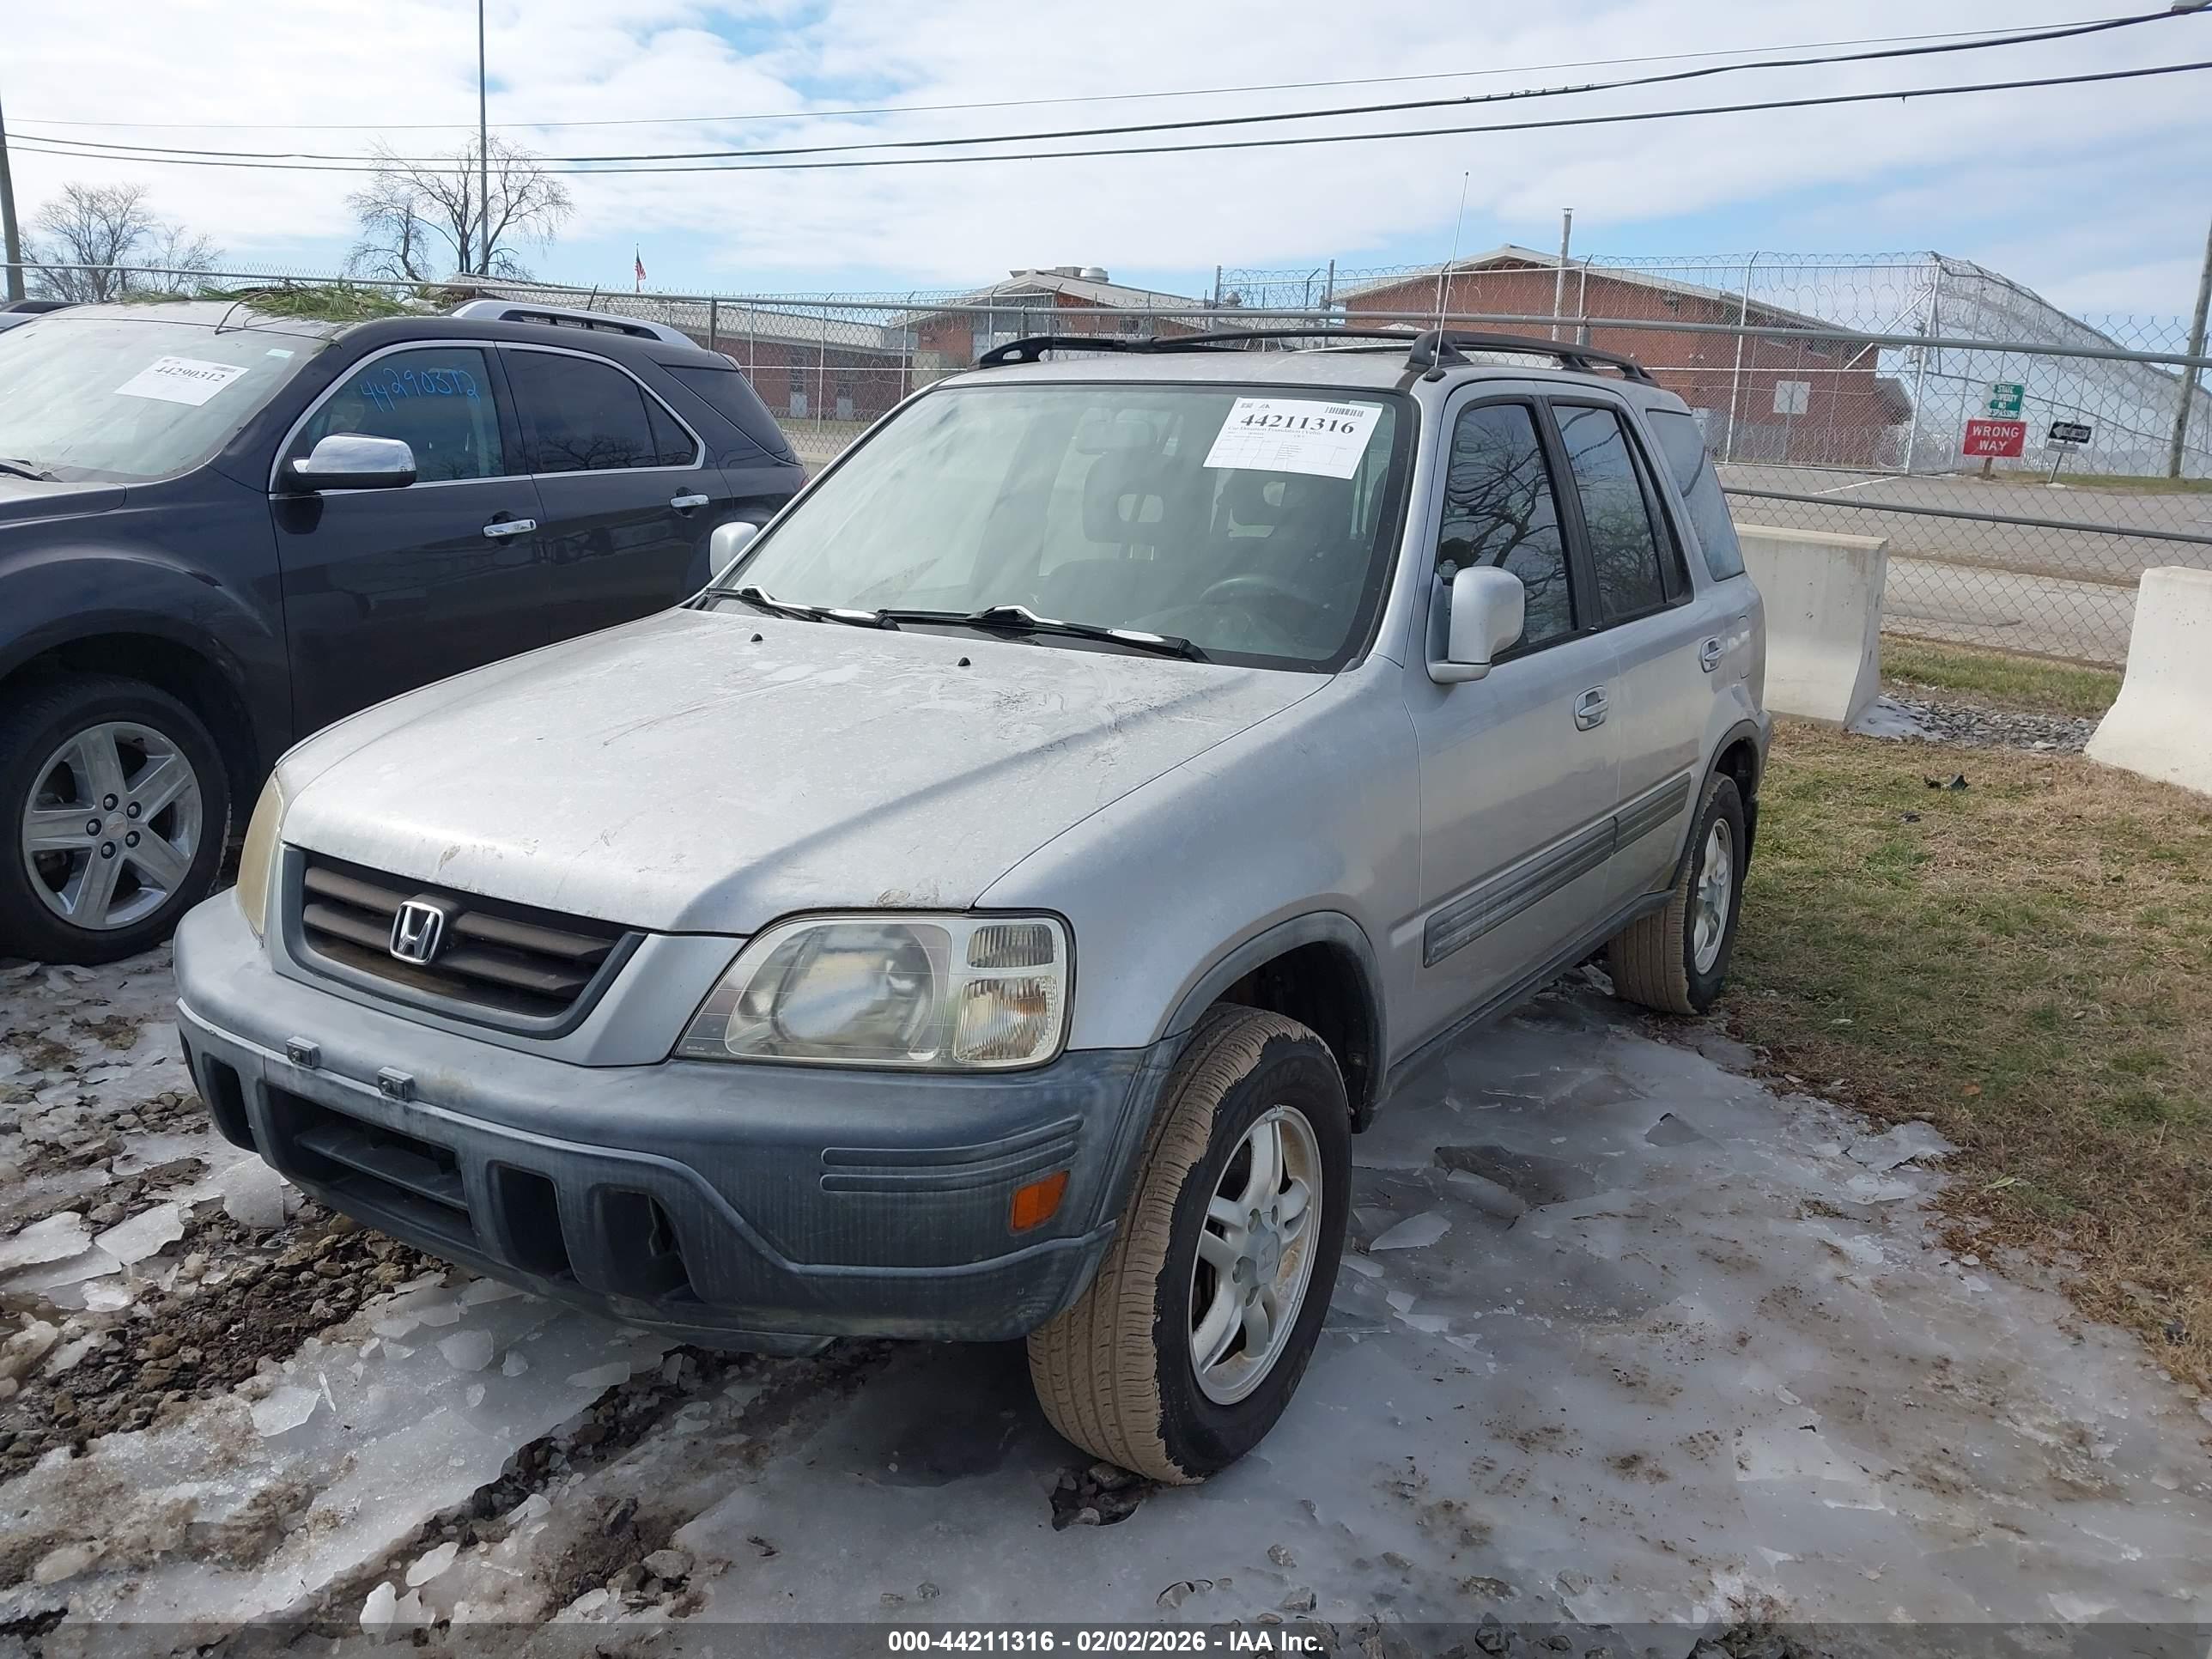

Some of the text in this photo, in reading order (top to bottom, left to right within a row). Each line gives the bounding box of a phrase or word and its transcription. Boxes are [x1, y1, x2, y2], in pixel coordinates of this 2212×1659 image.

[155, 366, 226, 382] 44290312
[1241, 414, 1358, 434] 44211316
[1972, 424, 2020, 438] WRONG
[1978, 440, 2008, 452] WAY
